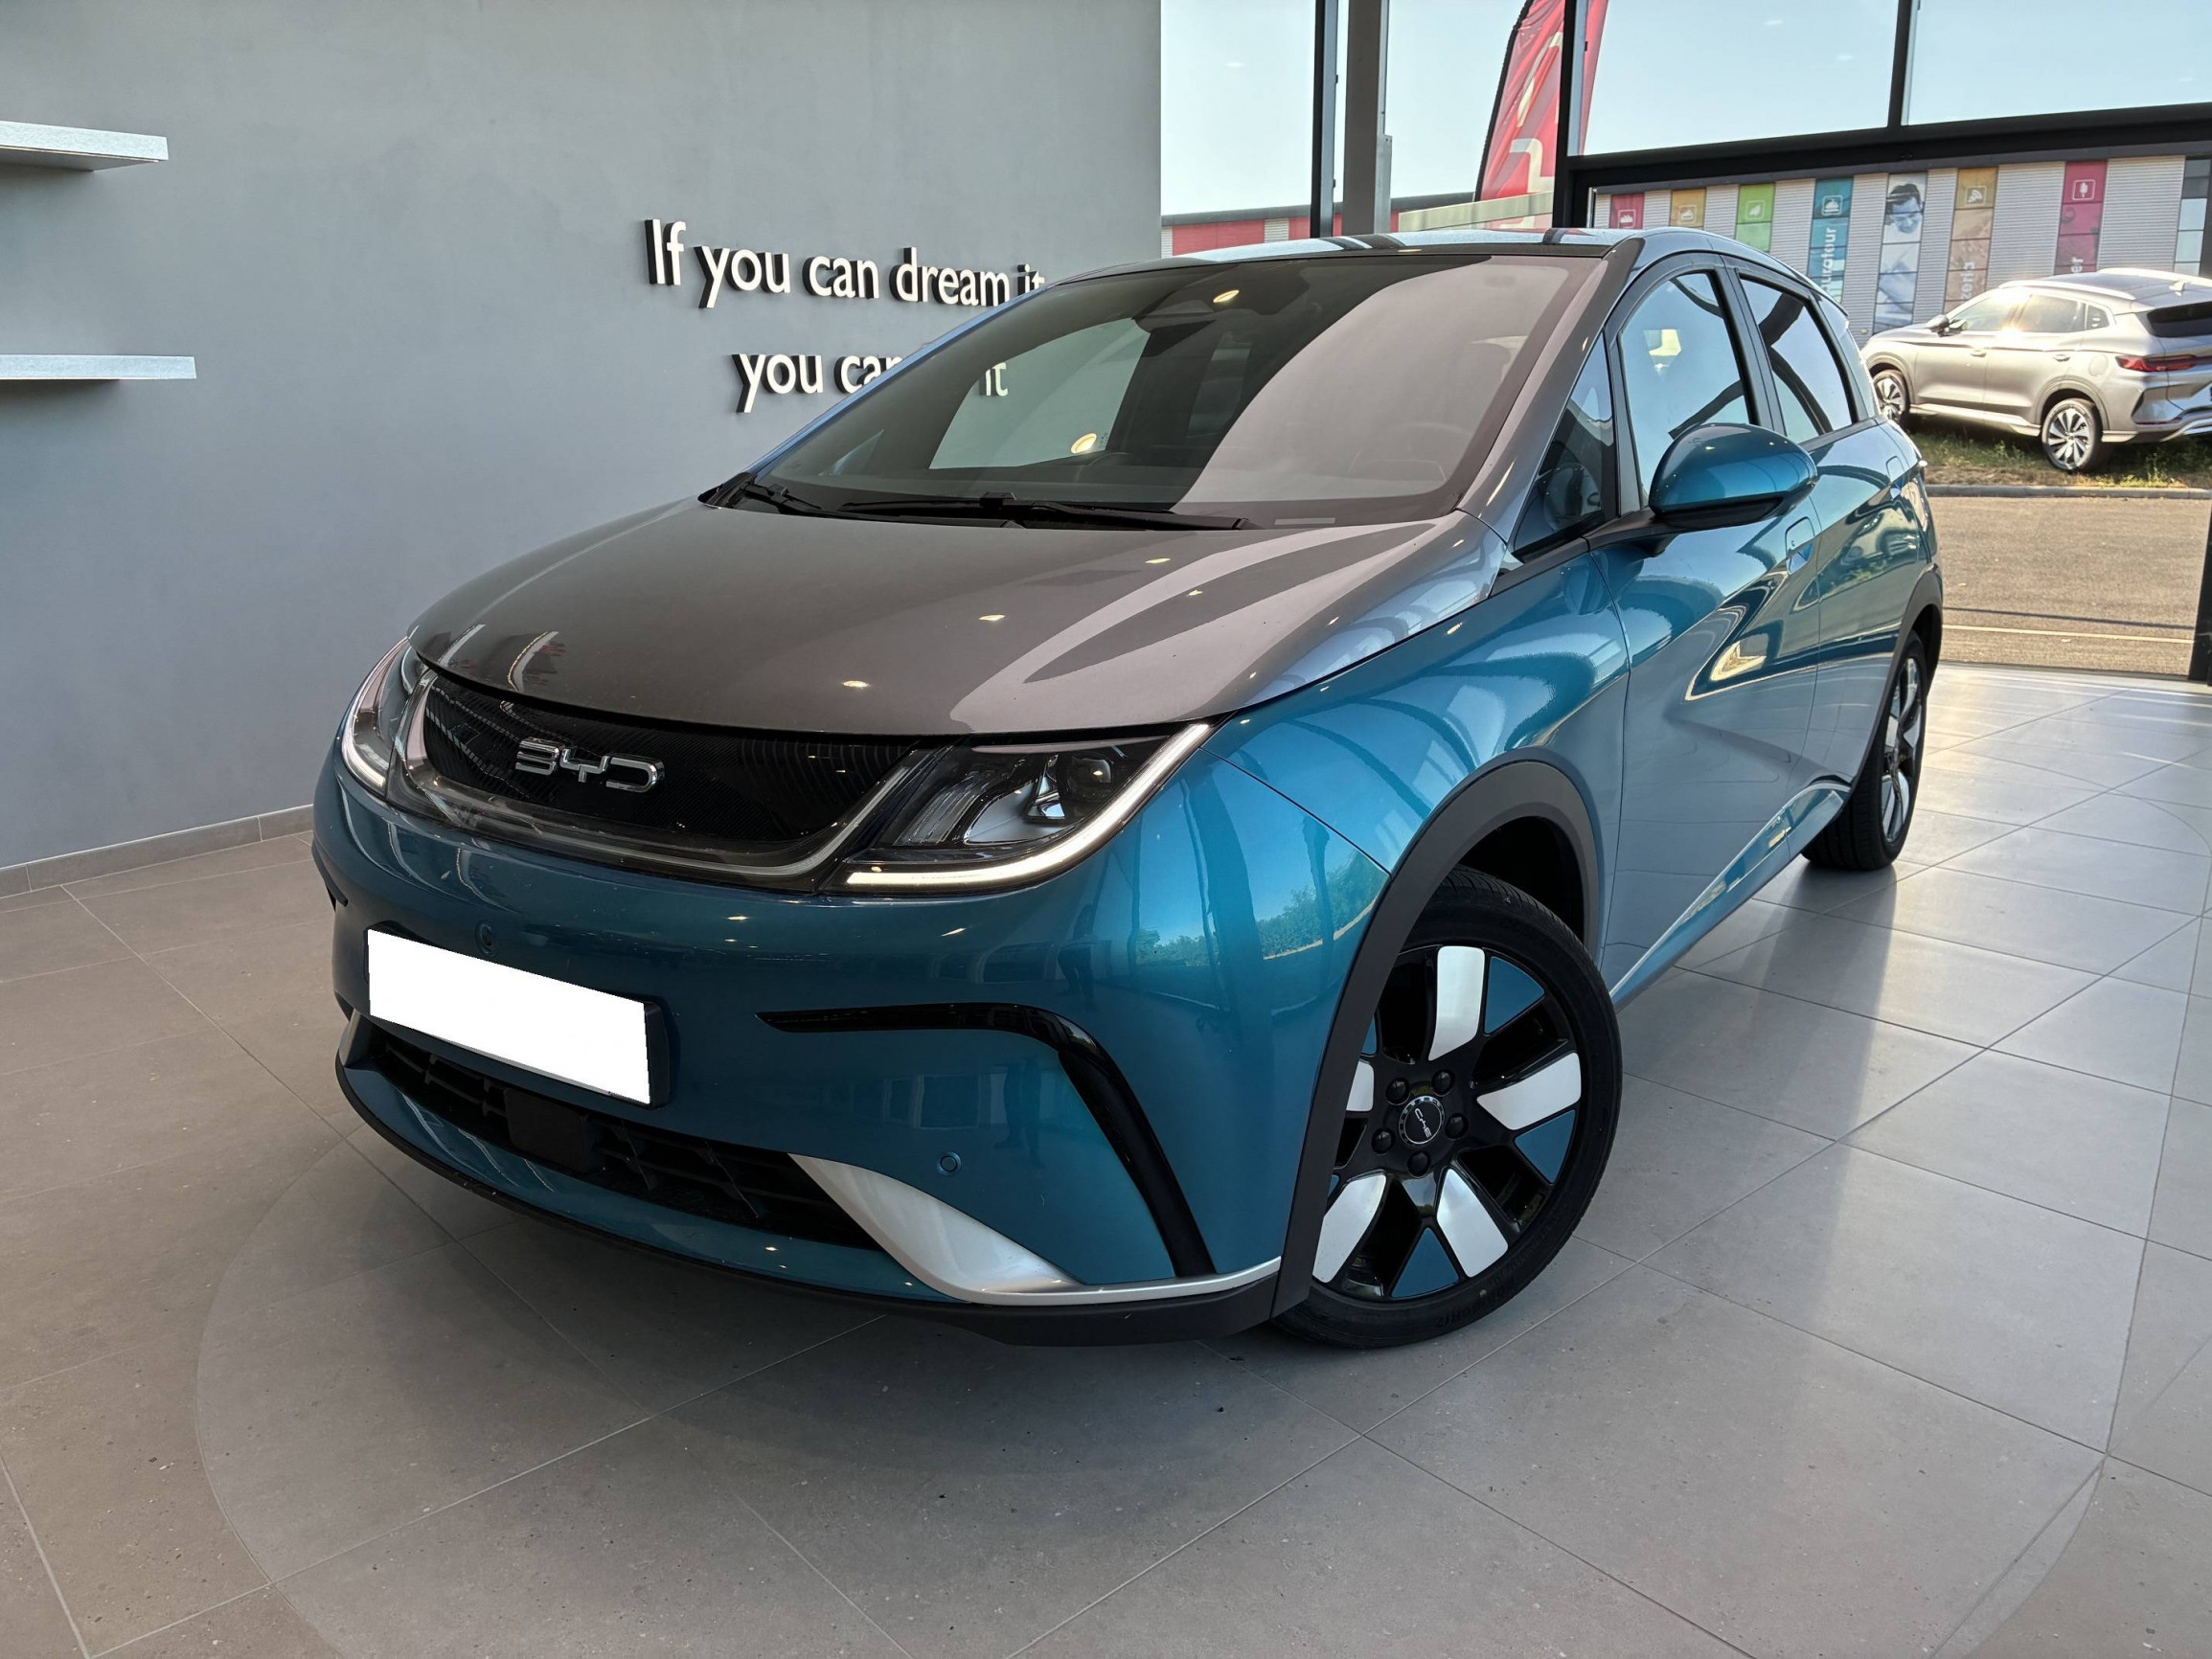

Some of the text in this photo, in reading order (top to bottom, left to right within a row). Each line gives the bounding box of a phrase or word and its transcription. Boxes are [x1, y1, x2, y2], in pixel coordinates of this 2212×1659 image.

[645, 218, 1045, 308] If you can dream it
[732, 352, 824, 413] you
[515, 737, 665, 793] BYD
